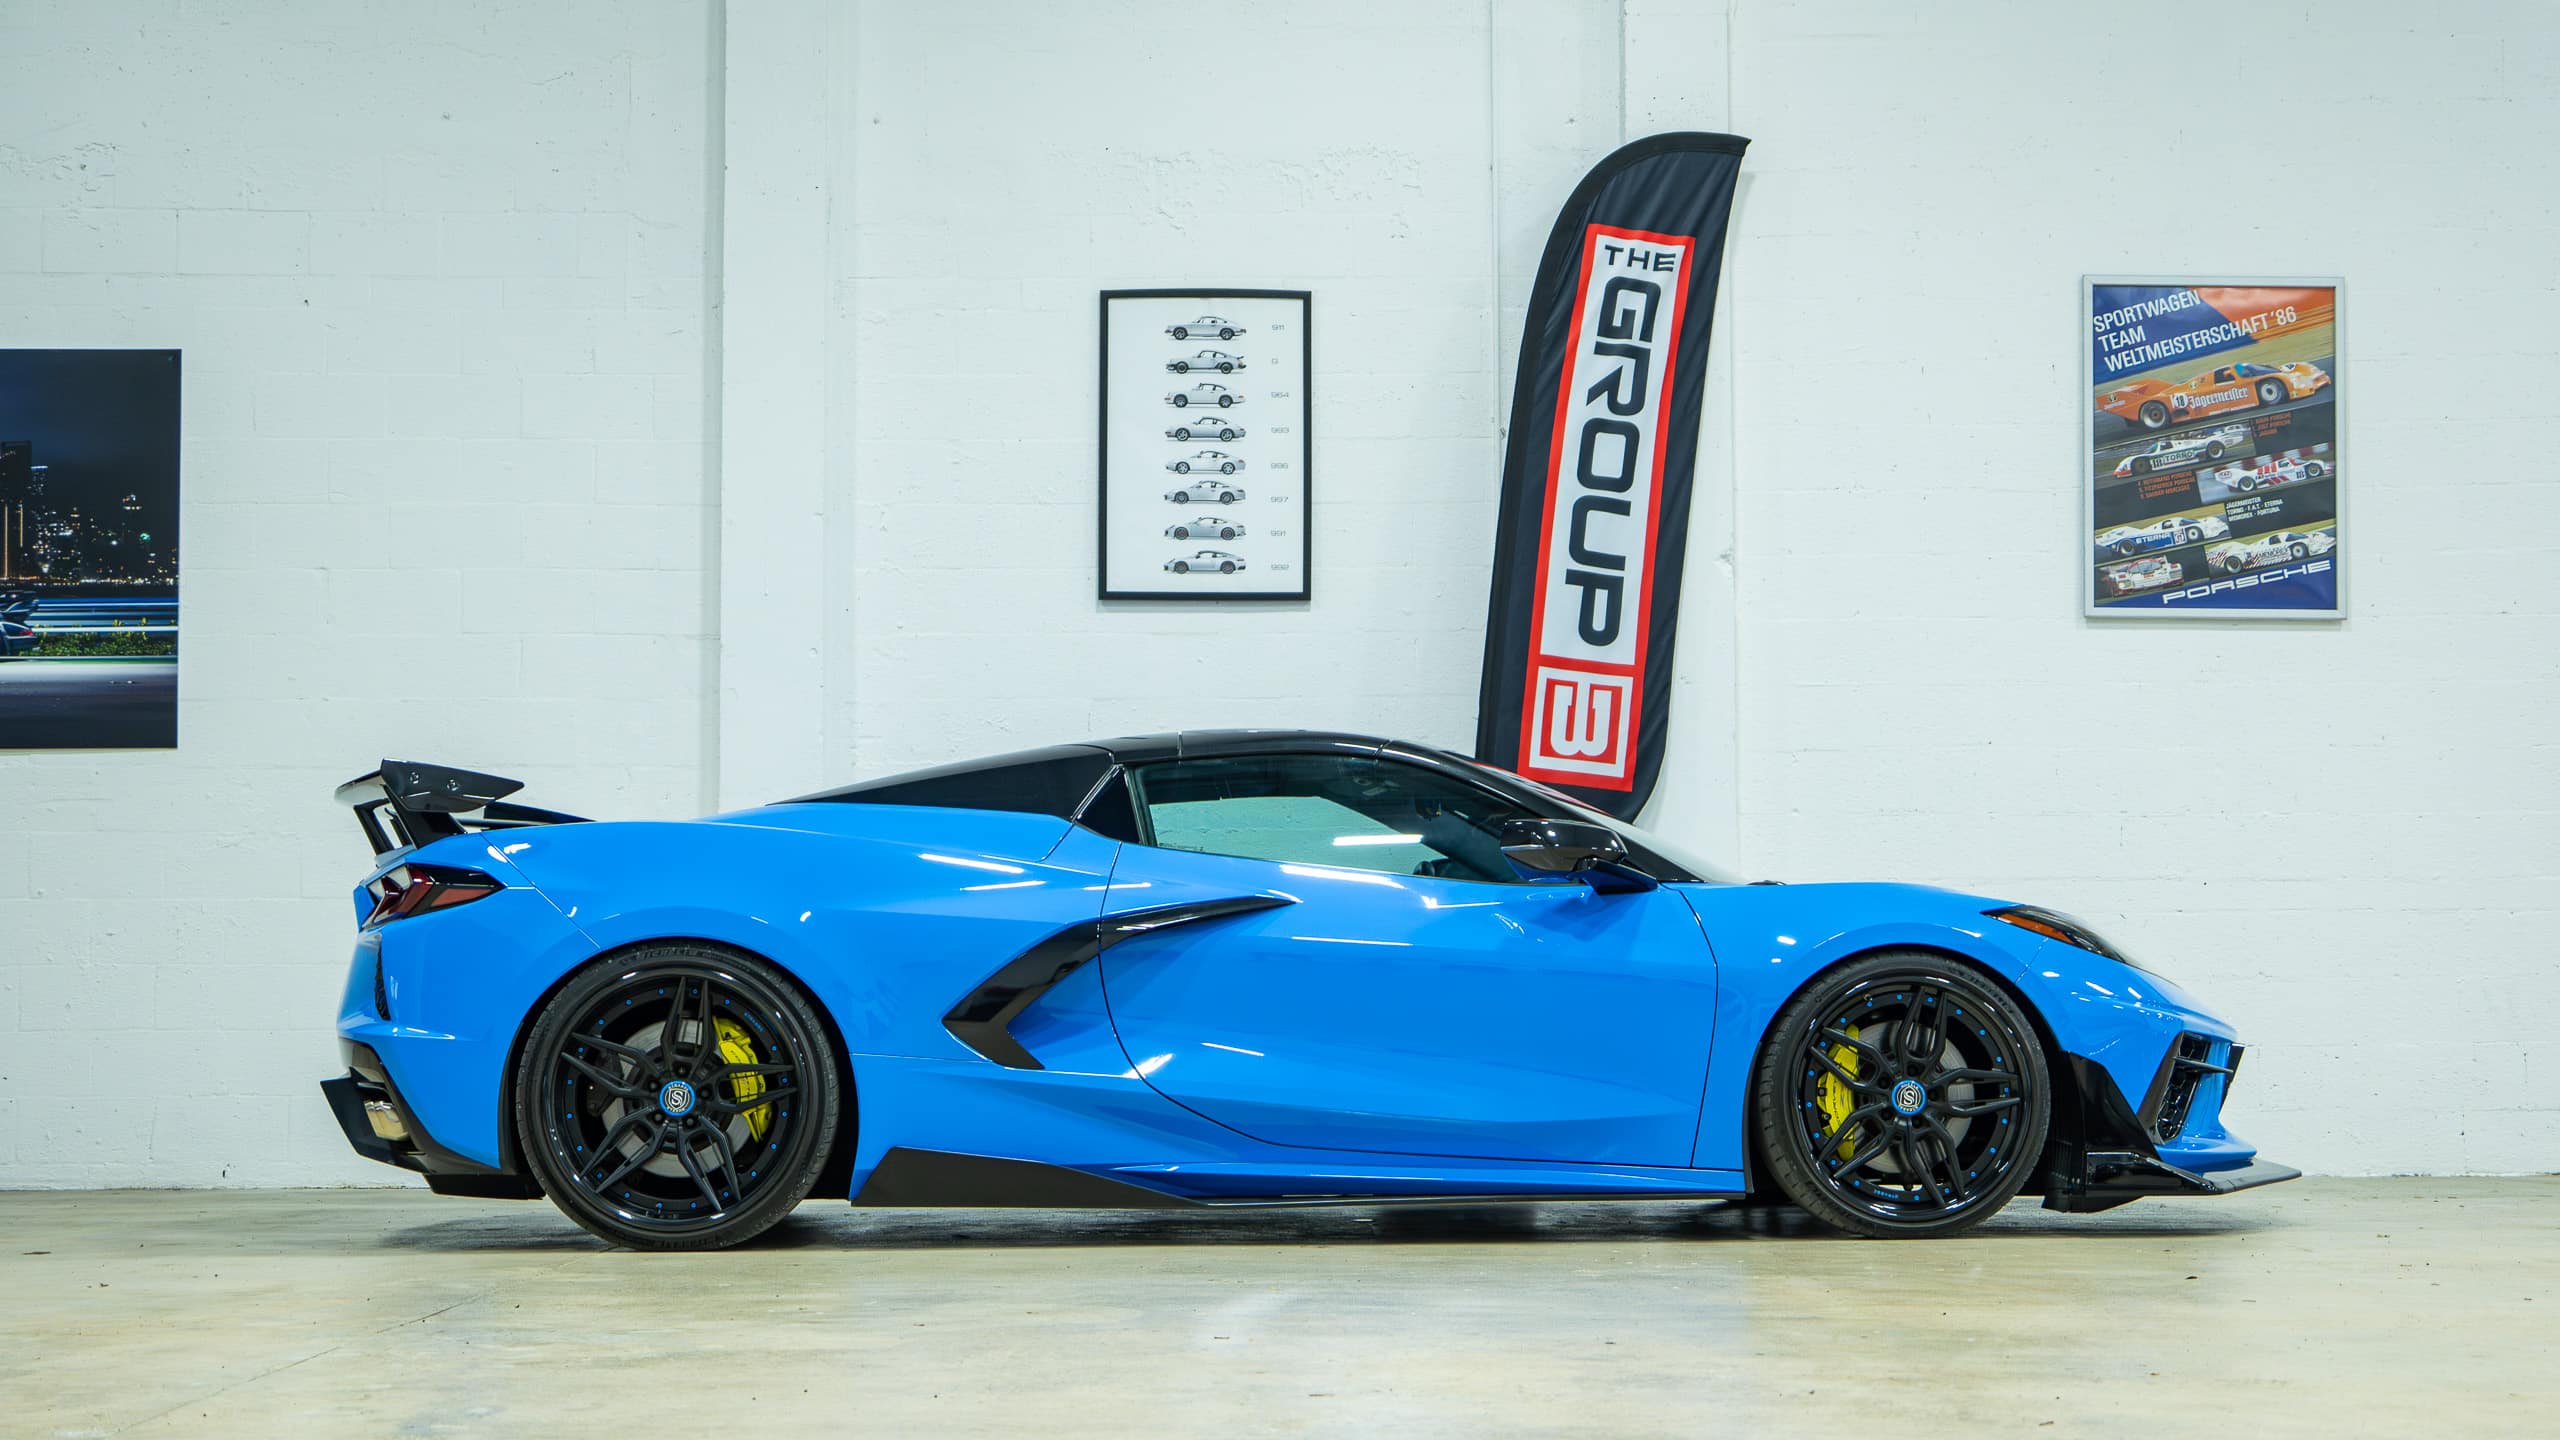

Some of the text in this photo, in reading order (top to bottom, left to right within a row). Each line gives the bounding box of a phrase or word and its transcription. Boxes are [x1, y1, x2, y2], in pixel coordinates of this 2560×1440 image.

[1604, 244, 1677, 272] THE
[2093, 289, 2201, 333] SPORTWAGEN
[2098, 325, 2147, 352] TEAM
[2104, 305, 2297, 373] WELTMEISTERSCHAFT '86
[1550, 276, 1661, 757] GROUP 3
[2162, 559, 2331, 604] PORSCHE
